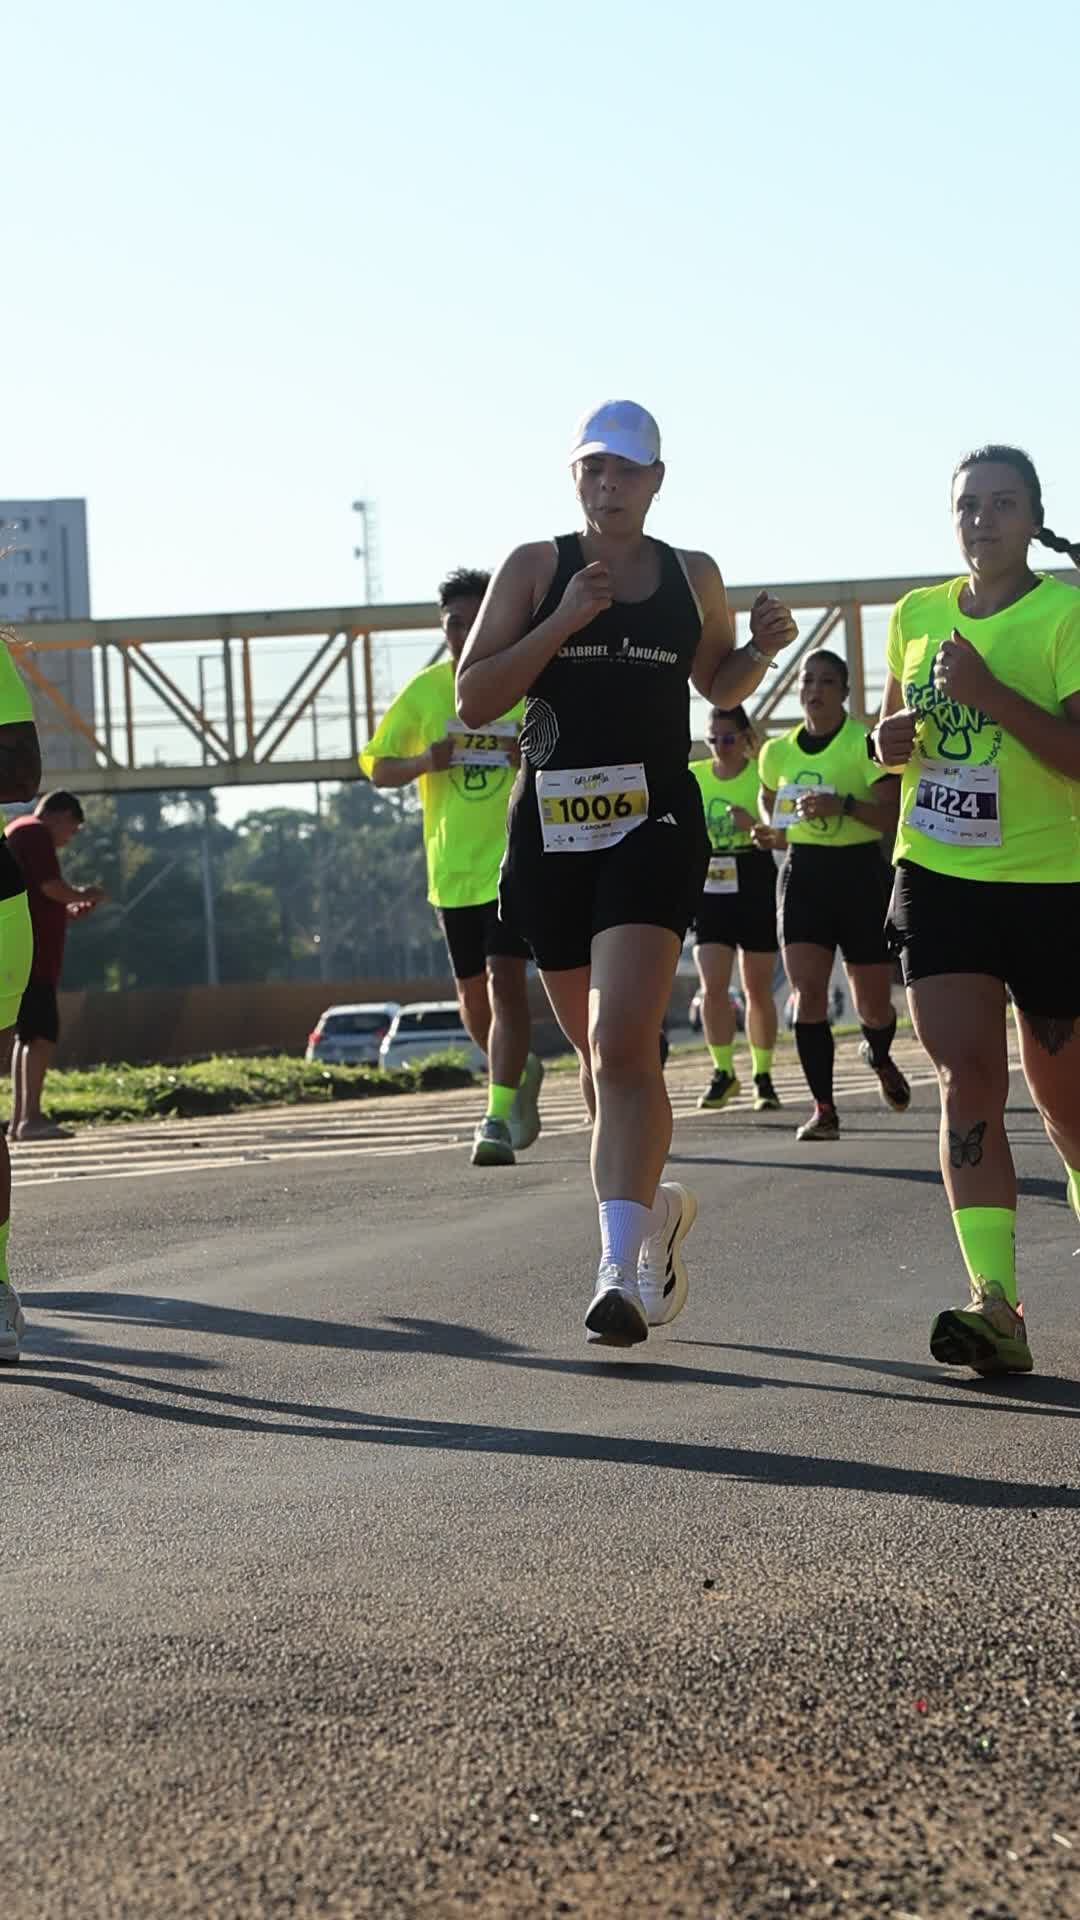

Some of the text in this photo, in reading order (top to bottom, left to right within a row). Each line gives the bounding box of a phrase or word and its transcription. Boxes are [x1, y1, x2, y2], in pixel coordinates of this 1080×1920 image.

[559, 645, 609, 658] GABRIEL
[464, 734, 498, 750] 723
[559, 794, 632, 823] 1006
[930, 785, 980, 818] 1224
